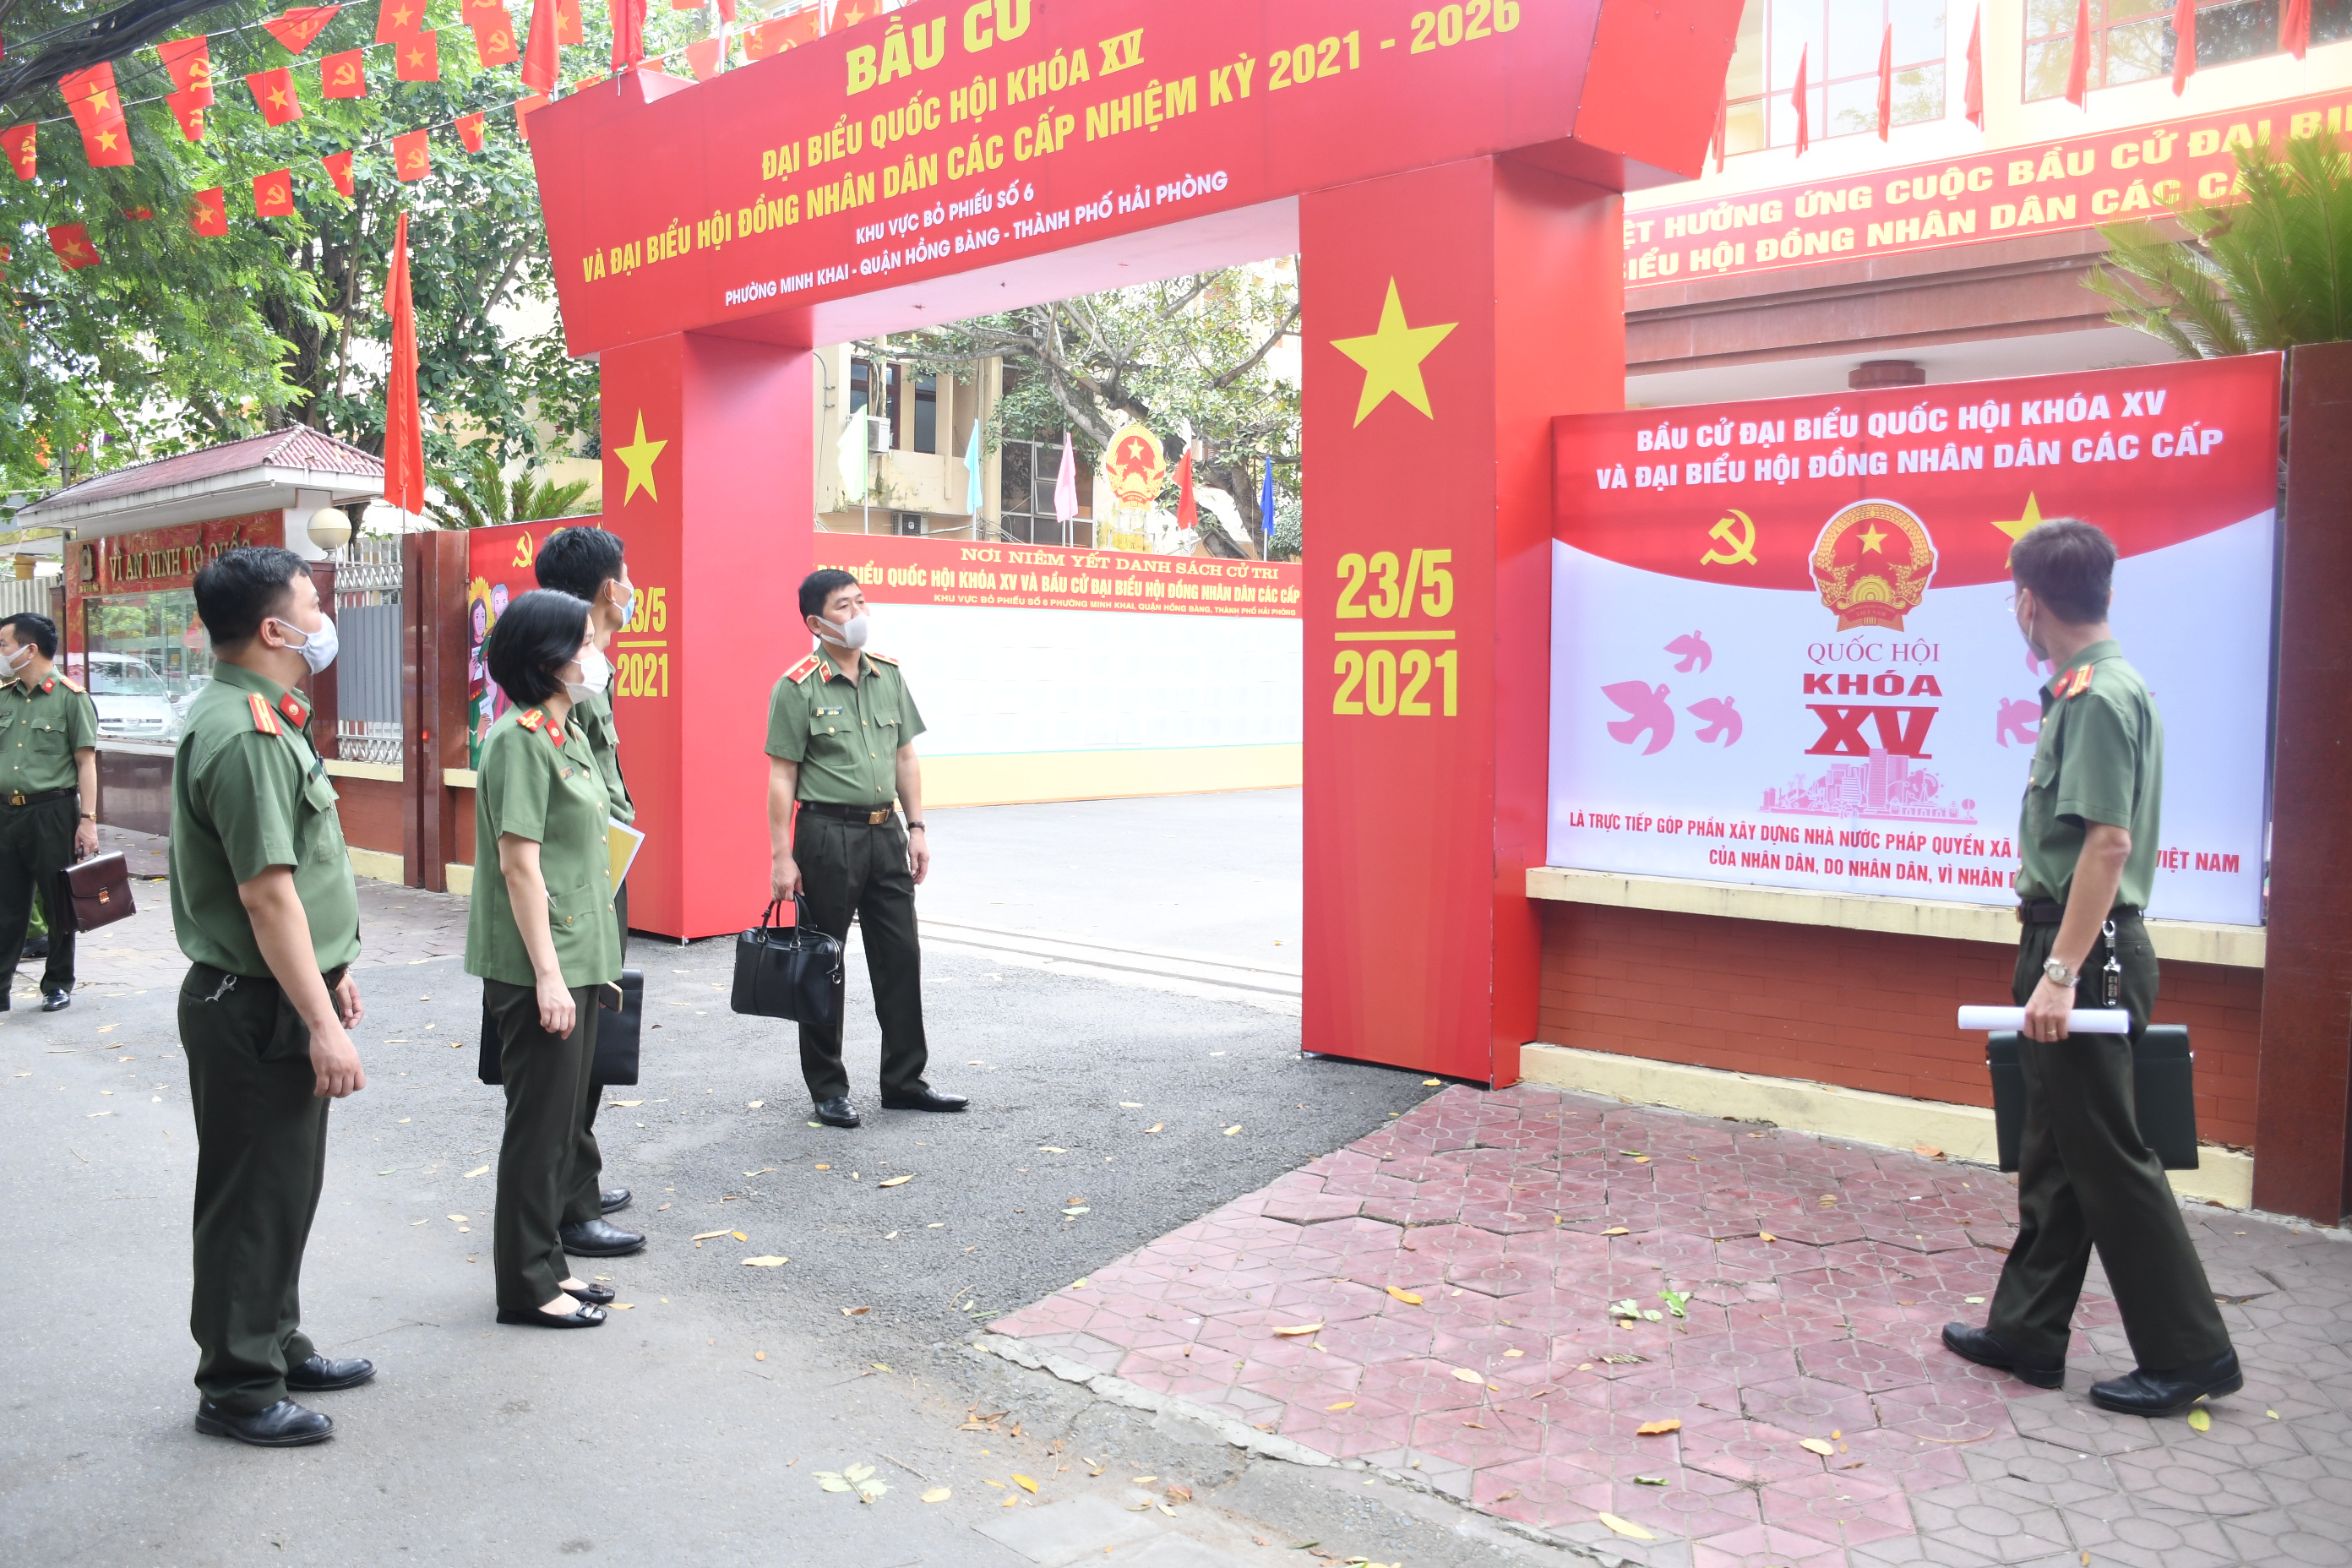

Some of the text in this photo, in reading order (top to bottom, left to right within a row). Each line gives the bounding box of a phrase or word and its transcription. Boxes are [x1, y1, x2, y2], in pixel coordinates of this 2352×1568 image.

[846, 16, 946, 96] BẦU
[762, 28, 1144, 182] ĐẠI BIỂU QUỐC HỘI KHÓA XV
[583, 0, 1521, 282] VÀ ĐẠI BIỂU HỘI ĐỒNG NHÂN DÂN CÁC CẤP NHIỆM KỲ 2021 - 2026
[857, 179, 1034, 244] KHU VỰC BỎ PHIẾU SỐ 6
[1665, 200, 1782, 238] HƯỞNG
[1795, 186, 1871, 218] ỨNG
[1886, 166, 1993, 204] CUỘC
[2008, 148, 2094, 186] BẦU
[2111, 131, 2178, 169] CỬ
[726, 280, 777, 306] PHƯỜNG
[780, 272, 813, 294] MINH
[817, 264, 848, 286] KHAI
[860, 249, 901, 275] QUẬN
[905, 237, 950, 265] HỒNG
[955, 227, 1000, 253] BÀNG
[1013, 209, 1070, 239] THÀNH
[1075, 190, 1113, 225] PHỐ
[1119, 184, 1150, 215] HẢI
[1156, 171, 1228, 205] PHÒNG
[1690, 240, 1745, 271] HỘI
[1756, 227, 1854, 262] ĐỒNG
[1867, 209, 1975, 247] NHÂN
[1990, 194, 2076, 230] DÂN
[1637, 389, 2166, 451] BẦU CỬ ĐẠI BIỂU QUỐC HỘI KHÓA XV
[1596, 421, 2223, 491] VÀ ĐẠI BIỂU HỘI ĐỒNG NHÂN DÂN CÁC CẤP
[126, 553, 143, 580] AN
[147, 548, 181, 578] NINH
[887, 563, 927, 587] QUỐC
[931, 567, 955, 591] HỘI
[959, 569, 997, 590] KHÓA
[999, 573, 1017, 591] XV
[1021, 571, 1038, 591] VÀ
[1042, 570, 1068, 593] BẦU
[1070, 573, 1089, 594] CỬ
[1091, 578, 1112, 598] ĐẠI
[1115, 574, 1142, 596] BIỂU
[1145, 579, 1165, 601] HỘI
[1168, 579, 1199, 600] ĐỒNG
[1201, 583, 1231, 601] NHÂN
[1234, 585, 1255, 602] DÂN
[1258, 585, 1277, 602] CÁC
[1281, 585, 1300, 603] CẤP
[961, 548, 1278, 579] NƠI NIÊM YẾT DANH SÁCH CỬ TRI
[1336, 548, 1454, 618] 23/5
[934, 594, 956, 602] KHU
[957, 595, 977, 604] VỰC
[980, 594, 995, 604] BỎ
[997, 595, 1026, 605] PHIẾU
[1027, 596, 1041, 606] SỐ
[1050, 598, 1088, 607] PHƯỜNG
[1114, 602, 1135, 610] KHAI,
[1138, 600, 1162, 612] QUẬN
[1163, 602, 1187, 612] HỒNG
[1188, 604, 1212, 613] BÀNG,
[1214, 606, 1239, 614] THÀNH
[1241, 606, 1257, 614] PHỐ
[1258, 607, 1270, 615] HẢI
[1271, 607, 1296, 616] PHÒNG
[618, 653, 668, 697] 2021
[1807, 634, 1940, 666] QUỐC HỘI
[1332, 649, 1457, 716] 2021
[1803, 669, 1942, 697] KHÓA
[1804, 704, 1939, 760] XV
[1570, 809, 1585, 827] LÀ
[1588, 813, 1620, 832] TRỰC
[1625, 814, 1652, 832] TIẾP
[1657, 815, 1683, 834] GÓP
[1688, 816, 1724, 838] PHẦN
[1729, 821, 1756, 840] XÂY
[1761, 825, 1799, 845] DỰNG
[1805, 826, 1834, 846] NHÀ
[1839, 829, 1880, 849] NƯỚC
[1886, 831, 1926, 852] PHÁP
[1932, 833, 1984, 856] QUYỀN
[1990, 837, 2012, 858] XÃ
[2195, 852, 2240, 873] NAM
[1709, 845, 1736, 867] CỦA
[1741, 850, 1780, 869] NHÂN
[1785, 852, 1818, 874] DÂN,
[1824, 858, 1843, 875] DO
[1848, 858, 1891, 879] NHÂN
[1897, 861, 1932, 884] DÂN,
[1938, 863, 1952, 884] VÌ
[1958, 866, 2003, 887] NHÂN
